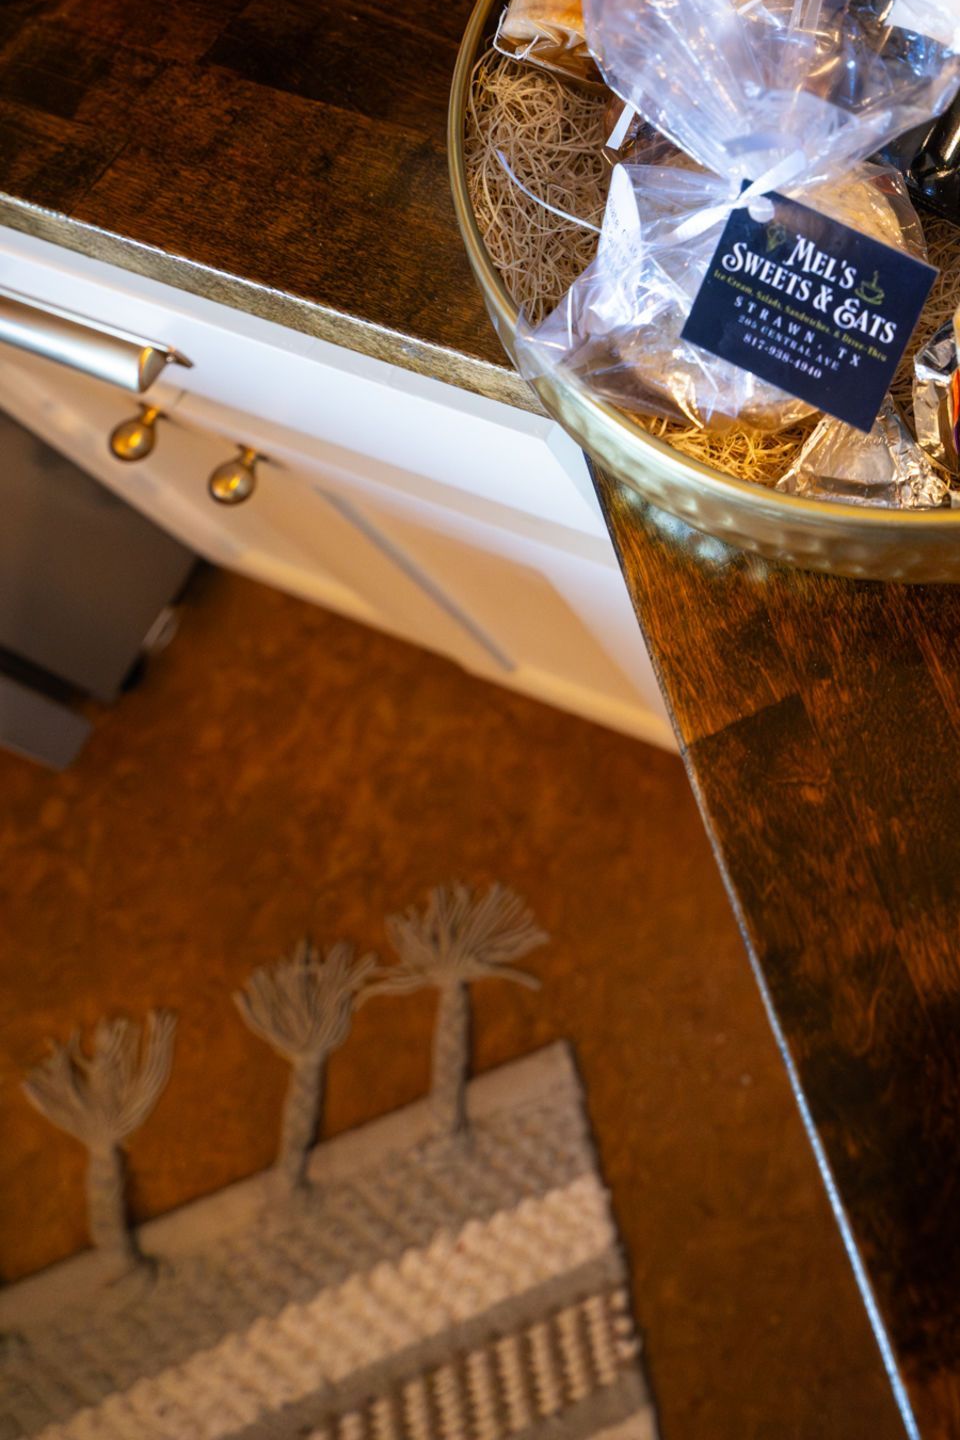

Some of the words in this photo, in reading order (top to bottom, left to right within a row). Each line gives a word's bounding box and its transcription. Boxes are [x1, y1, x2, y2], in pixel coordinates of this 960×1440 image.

[721, 242, 813, 302] SWEETS
[812, 284, 834, 314] &
[833, 298, 898, 345] EATS
[782, 234, 857, 290] MEL'S
[732, 294, 826, 350] STRAWN,
[835, 346, 862, 367] TX
[759, 324, 813, 357] CENTRAL
[814, 352, 840, 371] AVE
